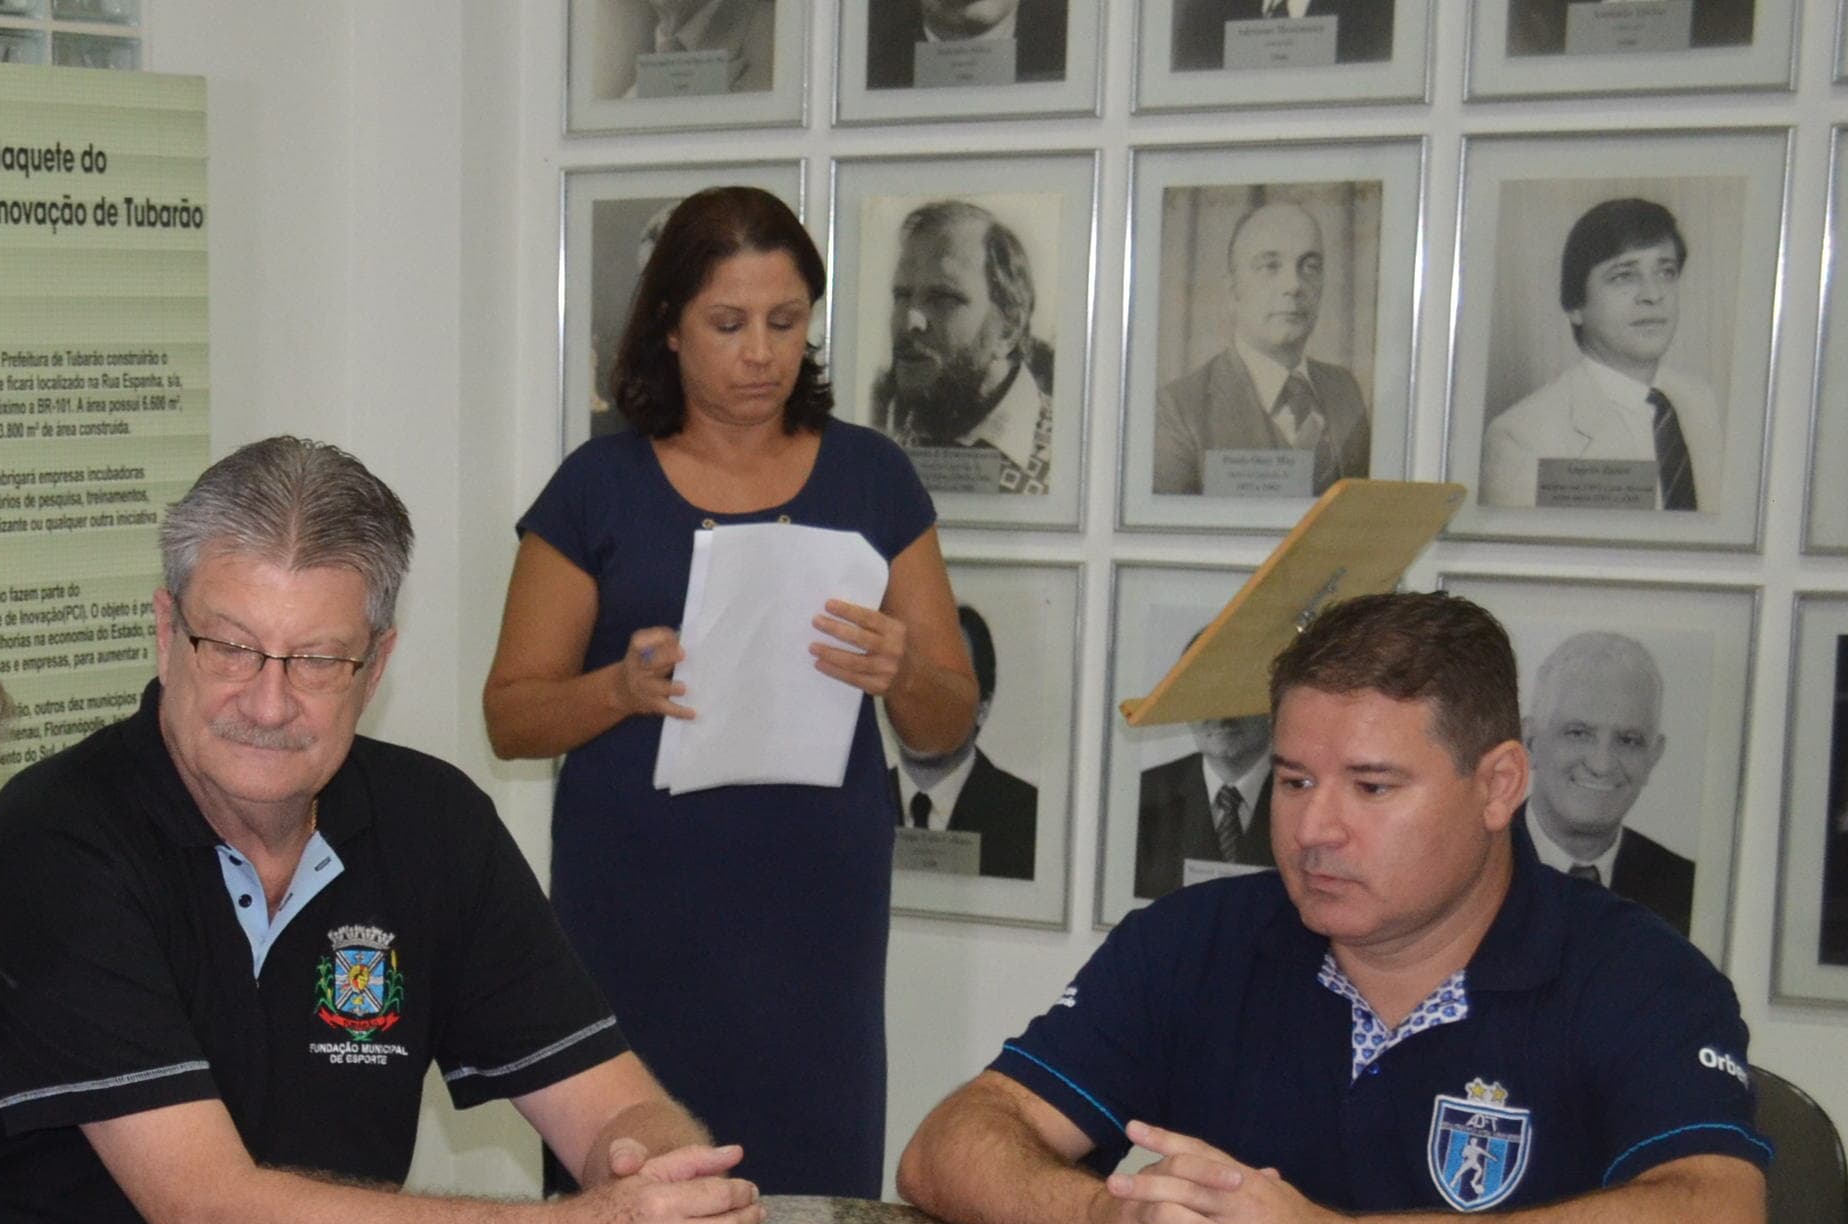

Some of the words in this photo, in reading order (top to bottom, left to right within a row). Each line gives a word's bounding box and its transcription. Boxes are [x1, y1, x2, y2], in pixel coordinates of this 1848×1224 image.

[81, 144, 107, 173] do
[93, 197, 118, 226] de
[125, 198, 203, 229] Tubarão
[1, 352, 49, 367] Prefeitura
[51, 352, 63, 366] de
[66, 351, 103, 366] Tubarão
[37, 374, 85, 390] localizado
[102, 373, 120, 389] Rua
[41, 422, 53, 437] de
[39, 470, 85, 488] empresas
[88, 465, 145, 481] incubadoras
[24, 493, 35, 508] de
[31, 519, 43, 531] ou
[45, 514, 88, 533] qualquer
[10, 586, 38, 601] fazem
[41, 585, 65, 603] parte
[67, 582, 80, 597] do
[5, 610, 17, 626] de
[91, 603, 98, 618] O
[101, 602, 130, 620] objeto
[48, 627, 94, 645] economia
[97, 625, 108, 641] do
[74, 652, 95, 669] para
[97, 646, 140, 663] aumentar
[35, 699, 65, 715] outros
[309, 1041, 359, 1055] FUNDAÇÃO
[361, 1043, 408, 1056] MUNICIPAL
[330, 1054, 343, 1064] DE
[346, 1054, 387, 1065] ESPORTE
